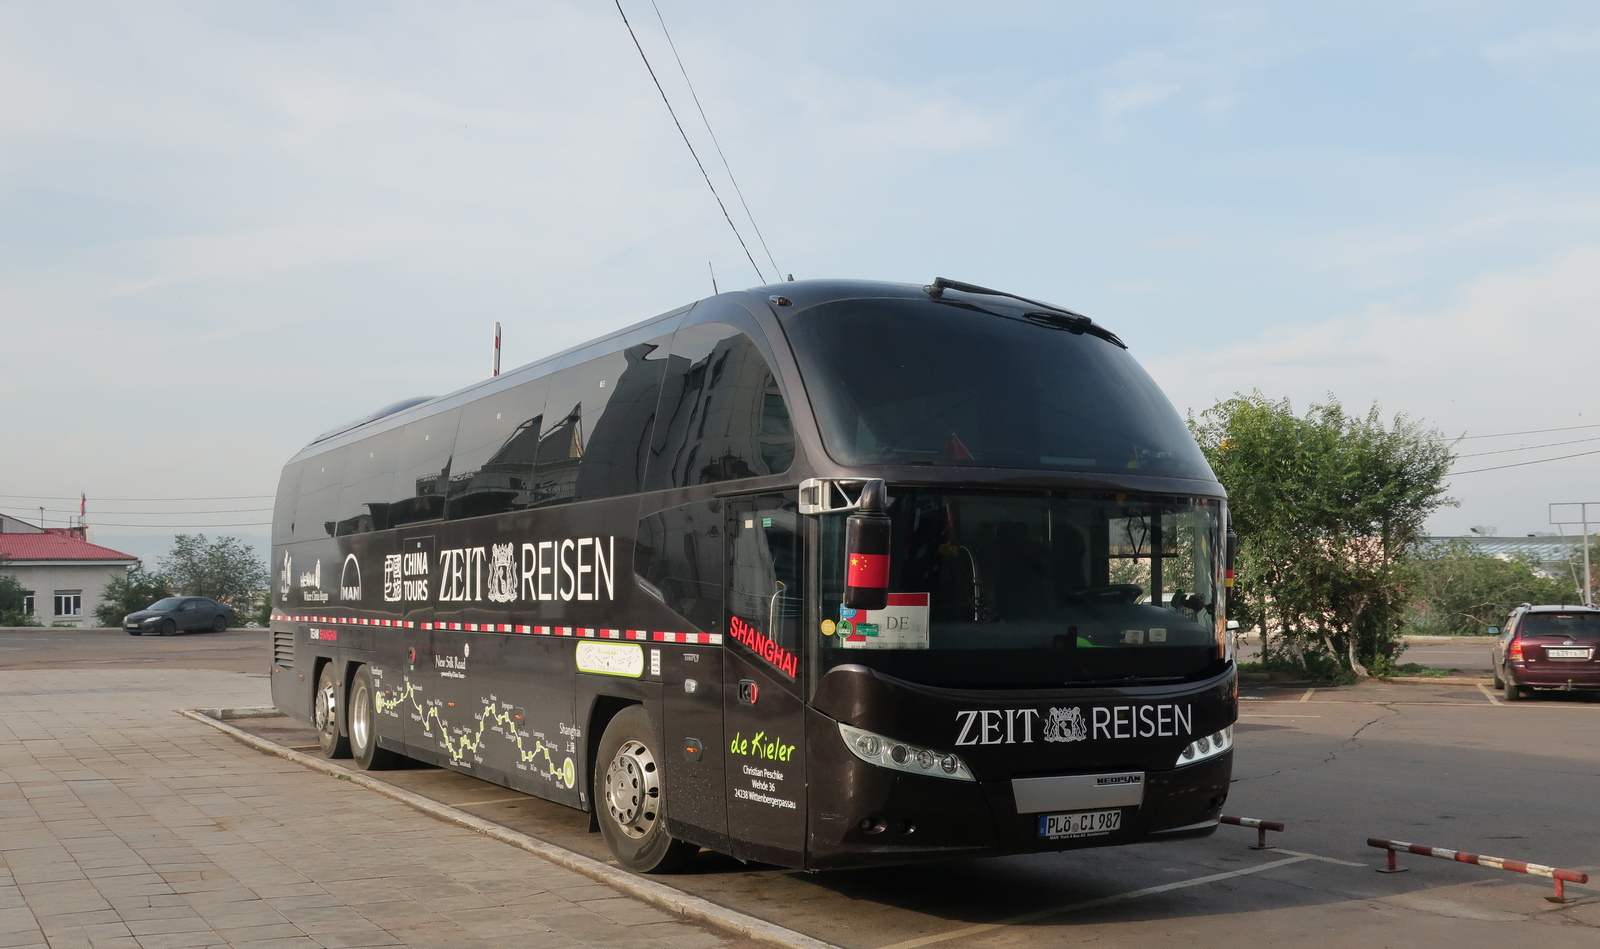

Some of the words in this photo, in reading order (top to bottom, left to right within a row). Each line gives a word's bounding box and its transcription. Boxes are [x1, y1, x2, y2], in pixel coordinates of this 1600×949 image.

[403, 551, 428, 576] CHINA
[439, 546, 486, 602] ZEIT
[522, 535, 614, 601] REISEN
[342, 586, 360, 600] MAN
[403, 579, 428, 601] TOURS
[886, 616, 909, 630] DE
[729, 615, 798, 678] SHANGHAI
[434, 654, 445, 668] New
[445, 655, 454, 669] Silk
[454, 656, 466, 670] Road
[559, 722, 581, 740] Shanghai
[955, 709, 1039, 746] ZEIT
[1092, 704, 1192, 740] REISEN
[731, 732, 748, 756] de
[751, 731, 796, 762] Kieler
[742, 764, 764, 778] Christian
[763, 768, 784, 781] Peschke
[1096, 775, 1141, 785] NEOPLAN
[751, 778, 769, 791] Wehde
[768, 782, 776, 792] 36
[734, 788, 749, 800] 24238
[749, 791, 796, 809] Wittenbergerpassau
[1047, 816, 1072, 834] PLÖ
[1080, 814, 1095, 831] CI
[1099, 811, 1121, 830] 987
